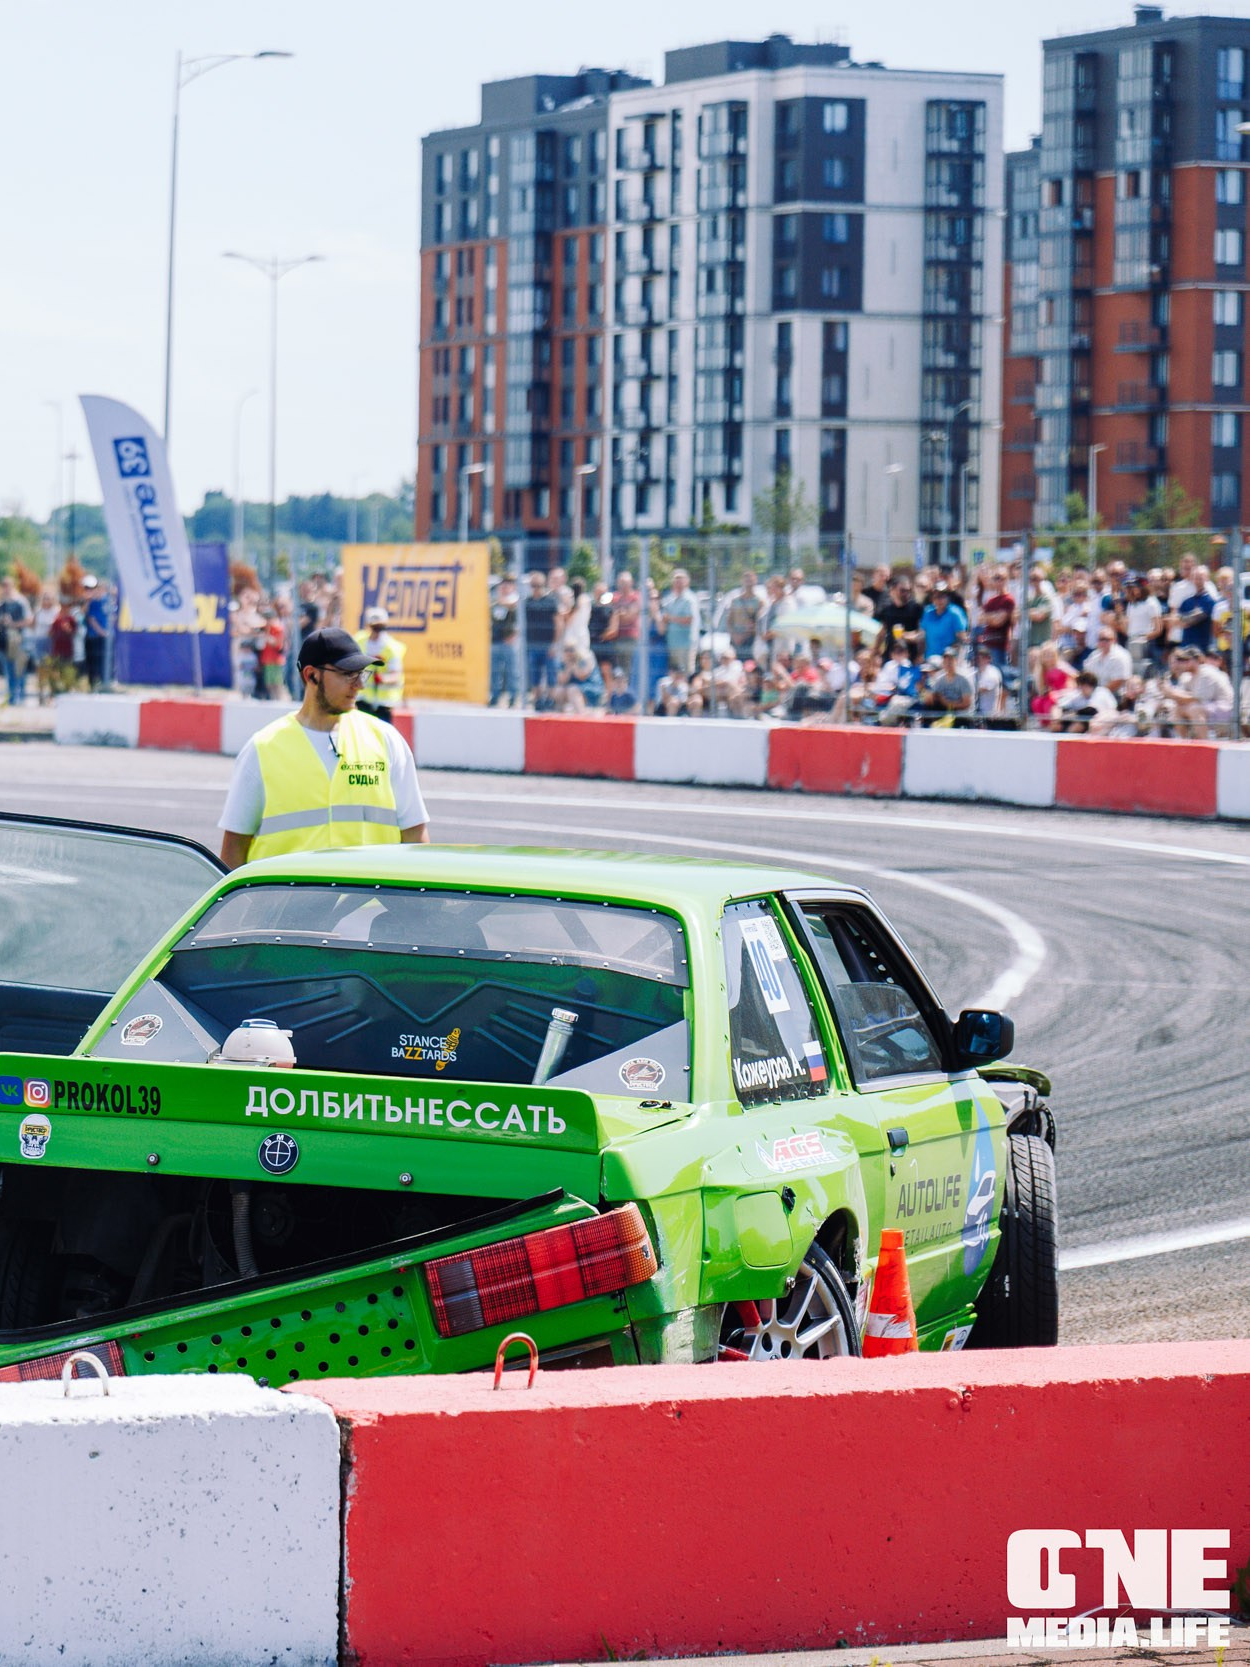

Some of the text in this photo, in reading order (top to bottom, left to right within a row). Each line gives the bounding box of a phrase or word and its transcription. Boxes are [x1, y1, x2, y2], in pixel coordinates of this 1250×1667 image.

[115, 438, 151, 478] 39
[348, 774, 379, 786] СУДЬЯ
[391, 1046, 457, 1061] BAZZTARDS
[399, 1034, 449, 1048] STANCE
[733, 1055, 792, 1089] Кожеуров
[54, 1080, 161, 1116] PROKOL39
[245, 1086, 567, 1134] ДОЛБИТЬНЕССАТЬ
[774, 1131, 825, 1162] AGS
[896, 1174, 962, 1219] AUTOLIFE
